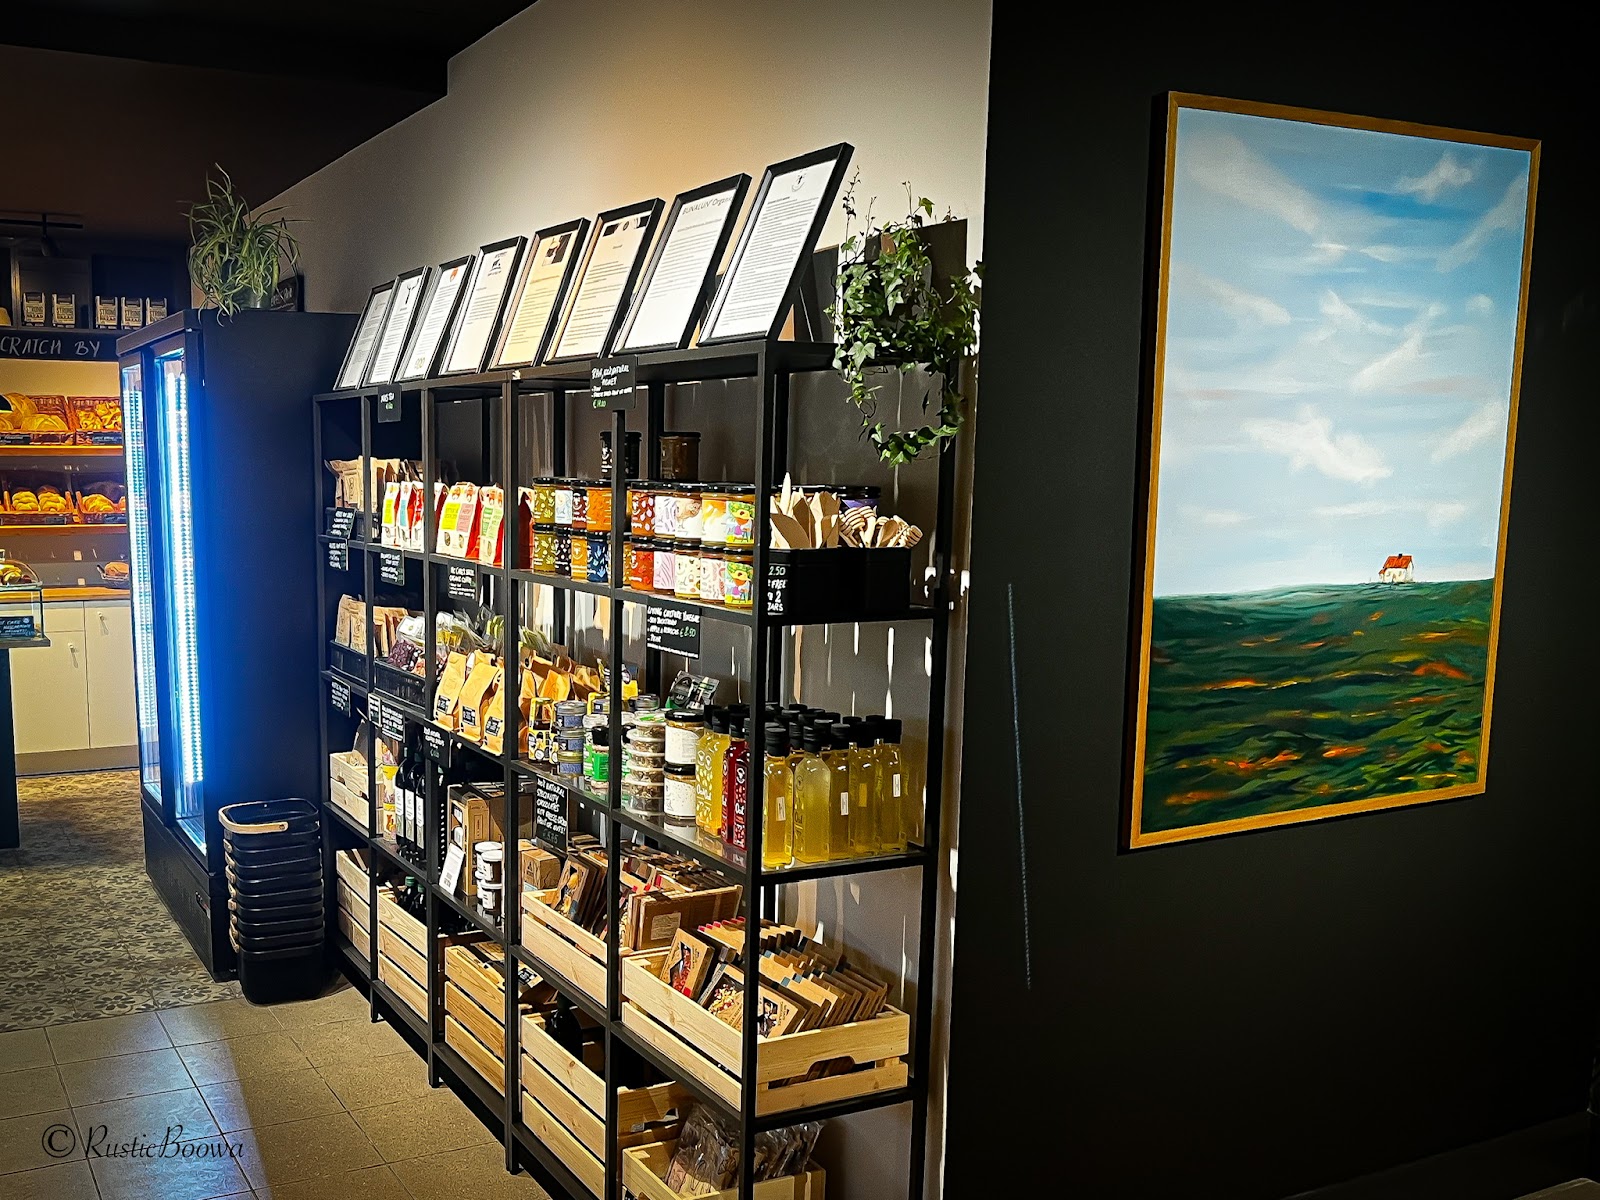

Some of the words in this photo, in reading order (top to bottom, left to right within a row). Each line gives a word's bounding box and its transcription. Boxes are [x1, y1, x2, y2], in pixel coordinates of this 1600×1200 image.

[75, 341, 100, 357] BY
[771, 579, 788, 589] FREE
[774, 590, 782, 603] 2
[647, 605, 663, 616] LIVING
[545, 782, 565, 798] NATURAL
